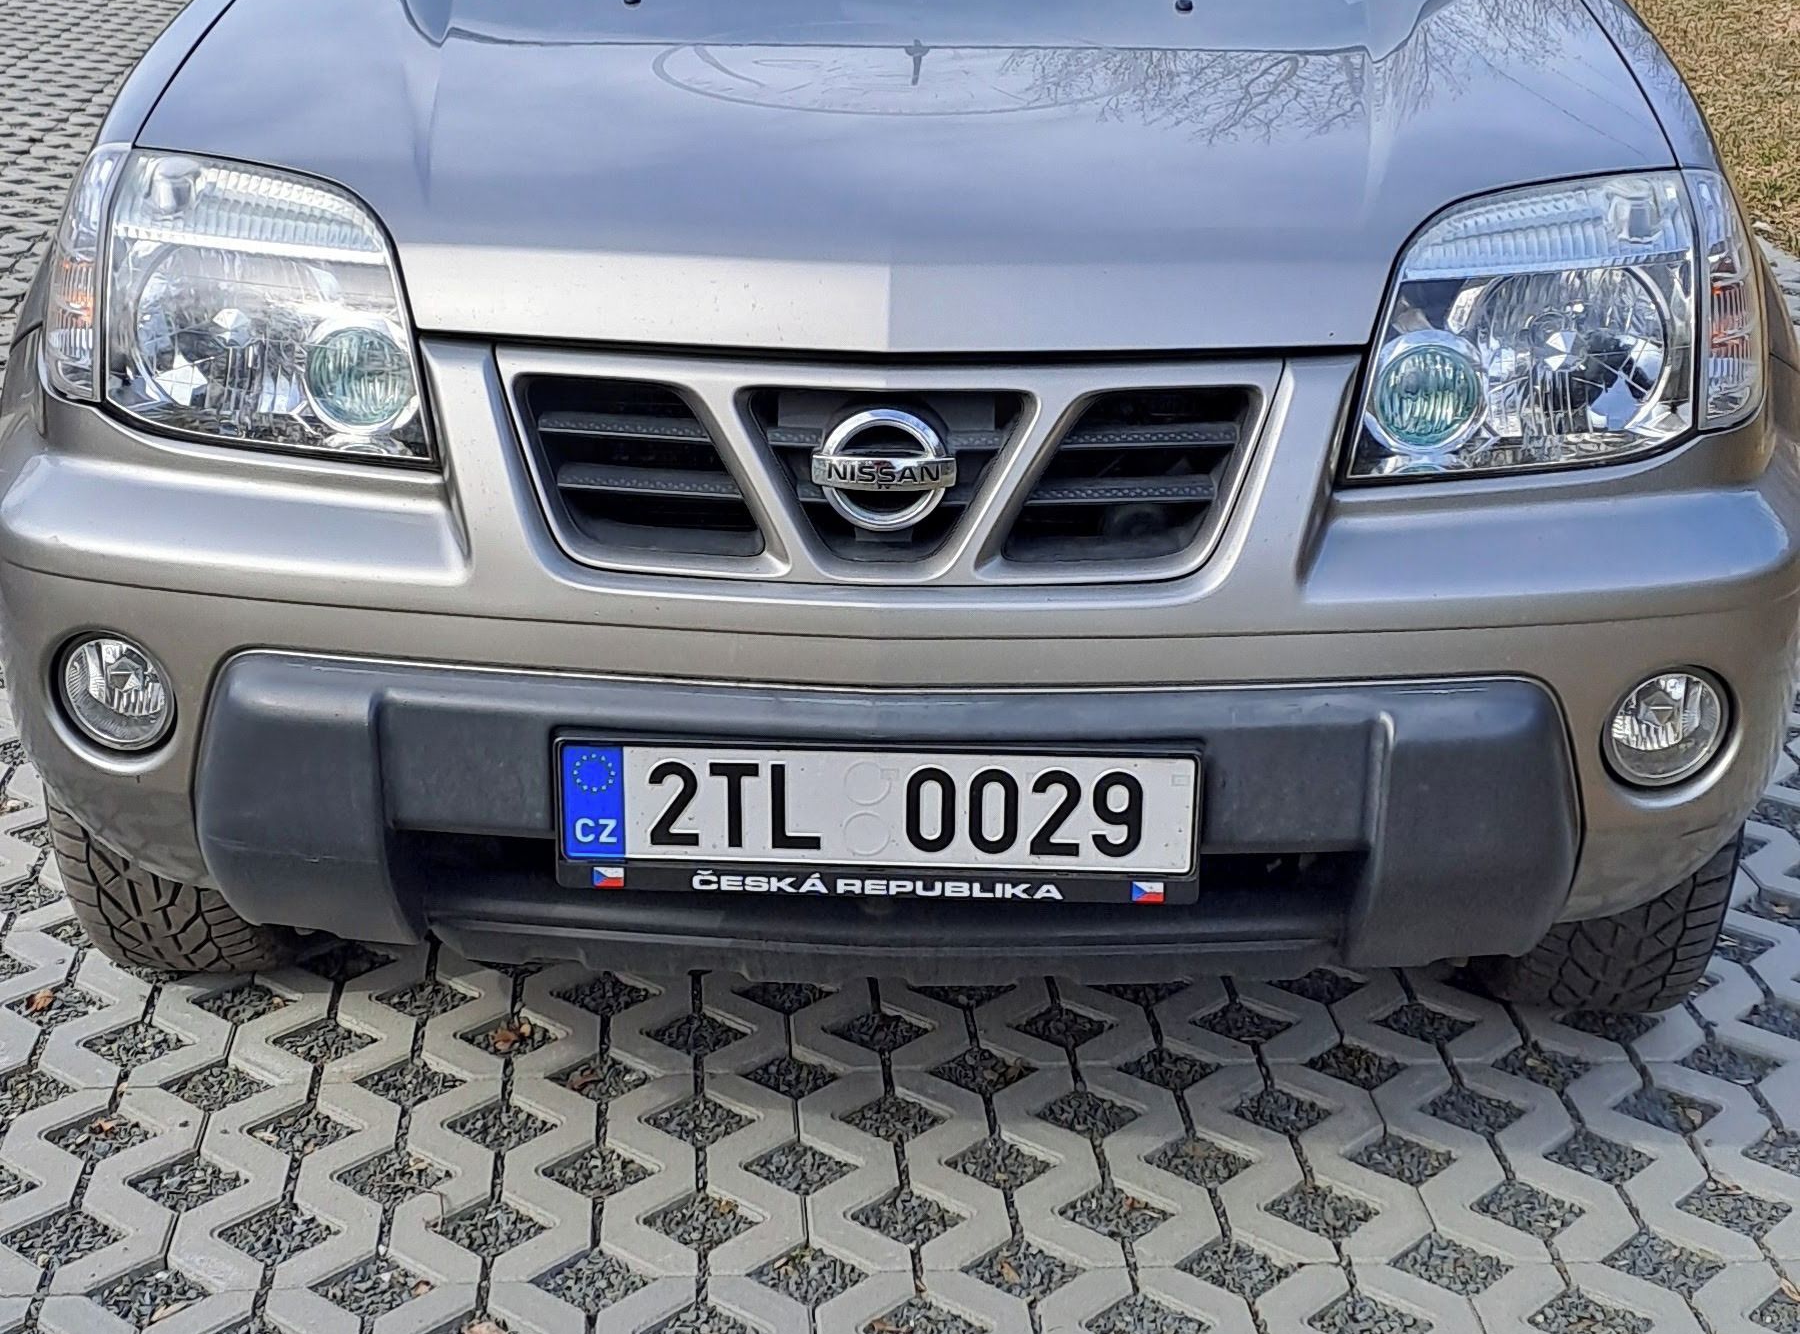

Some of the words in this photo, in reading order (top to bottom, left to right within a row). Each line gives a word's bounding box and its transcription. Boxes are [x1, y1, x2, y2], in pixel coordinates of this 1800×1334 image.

[826, 461, 942, 483] NISSAN
[648, 760, 822, 850] 2TL
[905, 766, 1143, 858] 0029
[574, 817, 618, 844] CZ
[691, 869, 829, 894] ČESKÁ
[835, 878, 1064, 900] REPUBLIKA
